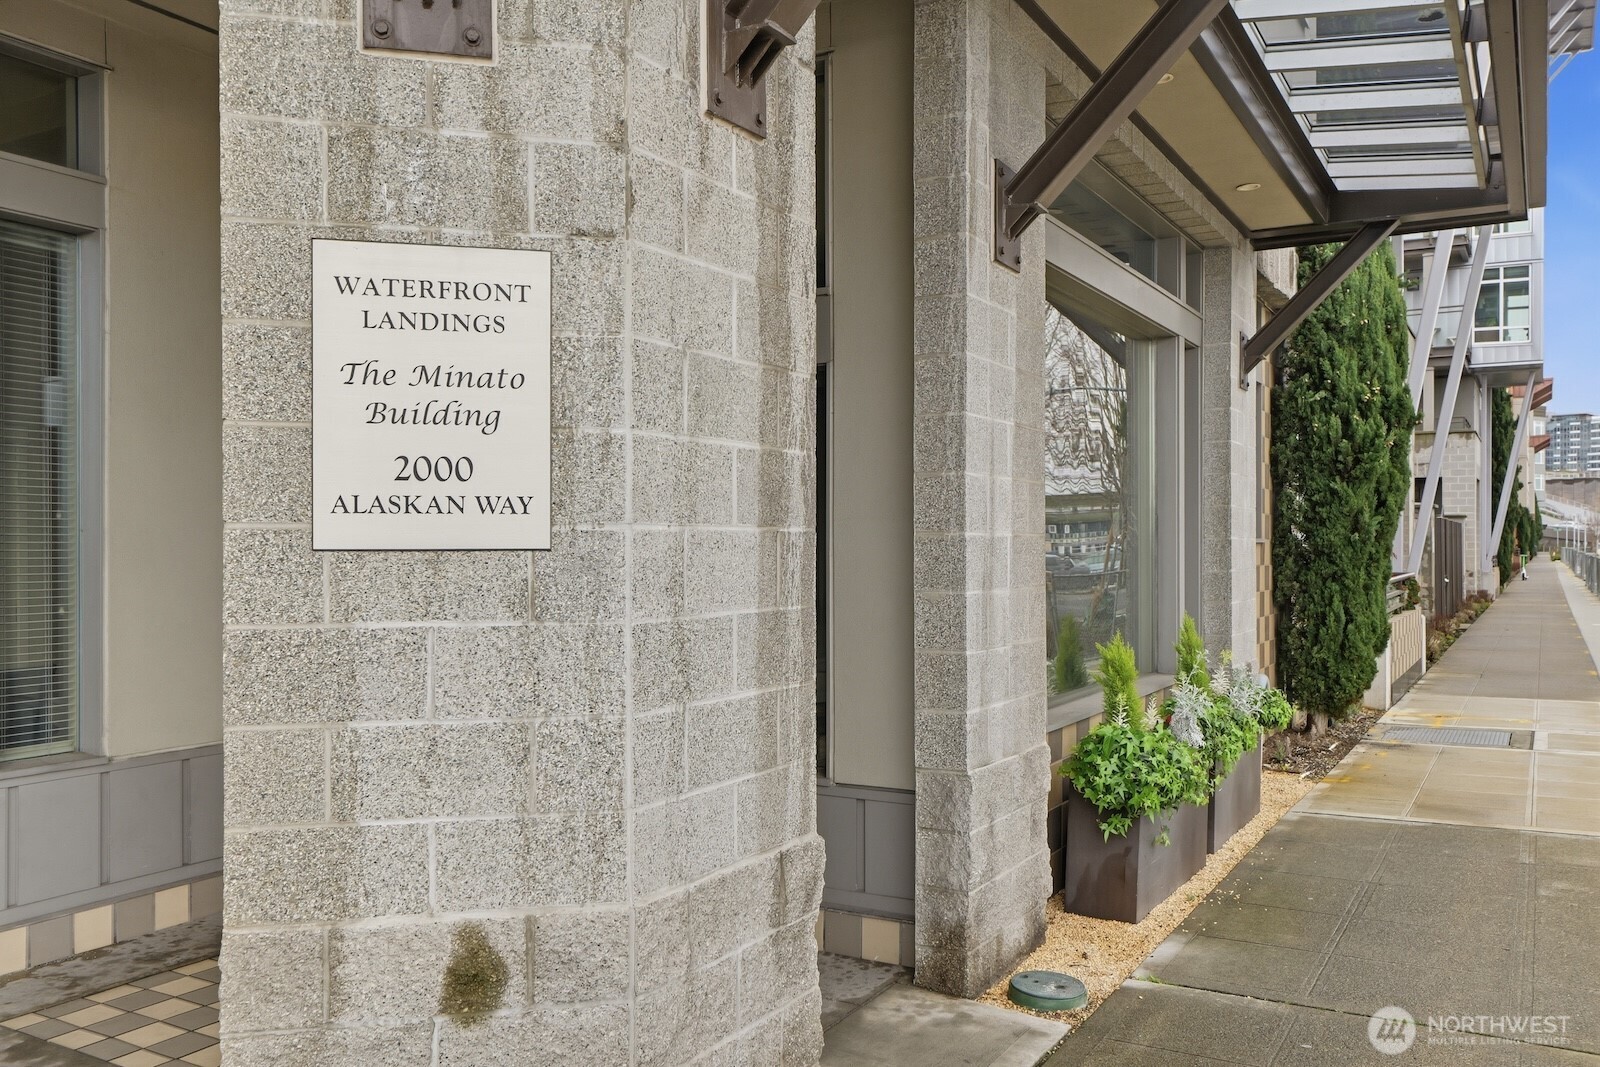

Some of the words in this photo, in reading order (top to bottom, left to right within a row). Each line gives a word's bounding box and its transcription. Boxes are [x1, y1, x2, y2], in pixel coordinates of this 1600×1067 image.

[333, 275, 532, 303] WATERFRONT
[362, 310, 505, 334] LANDINGS
[340, 359, 396, 386] The
[408, 364, 525, 390] Minato
[365, 399, 501, 436] Building
[394, 455, 474, 483] 2000
[330, 494, 466, 515] ALASKAN
[474, 495, 534, 515] WAY
